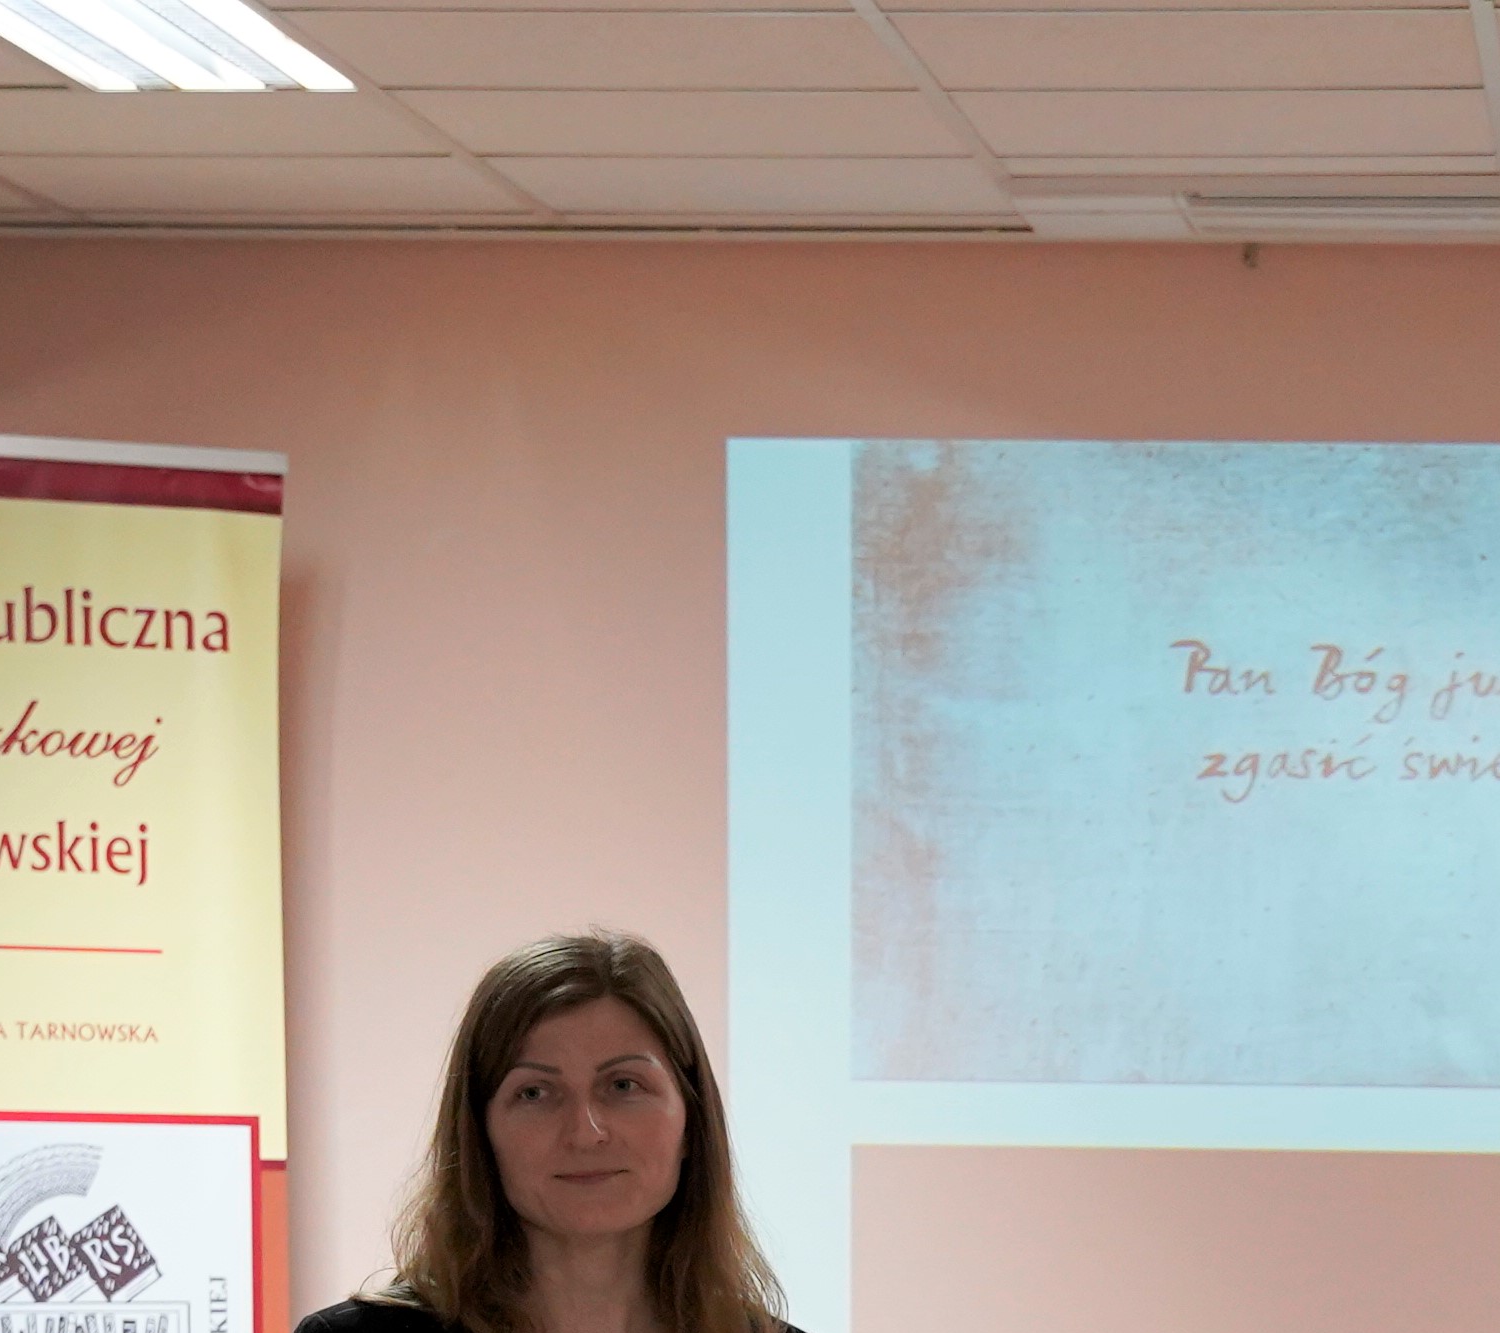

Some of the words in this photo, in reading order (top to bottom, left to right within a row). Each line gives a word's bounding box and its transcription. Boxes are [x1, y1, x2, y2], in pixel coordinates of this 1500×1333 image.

[1169, 639, 1278, 697] Pan
[1310, 644, 1409, 724] Bóg
[1196, 735, 1380, 803] zgasić
[17, 1020, 159, 1044] TARNOWSKA
